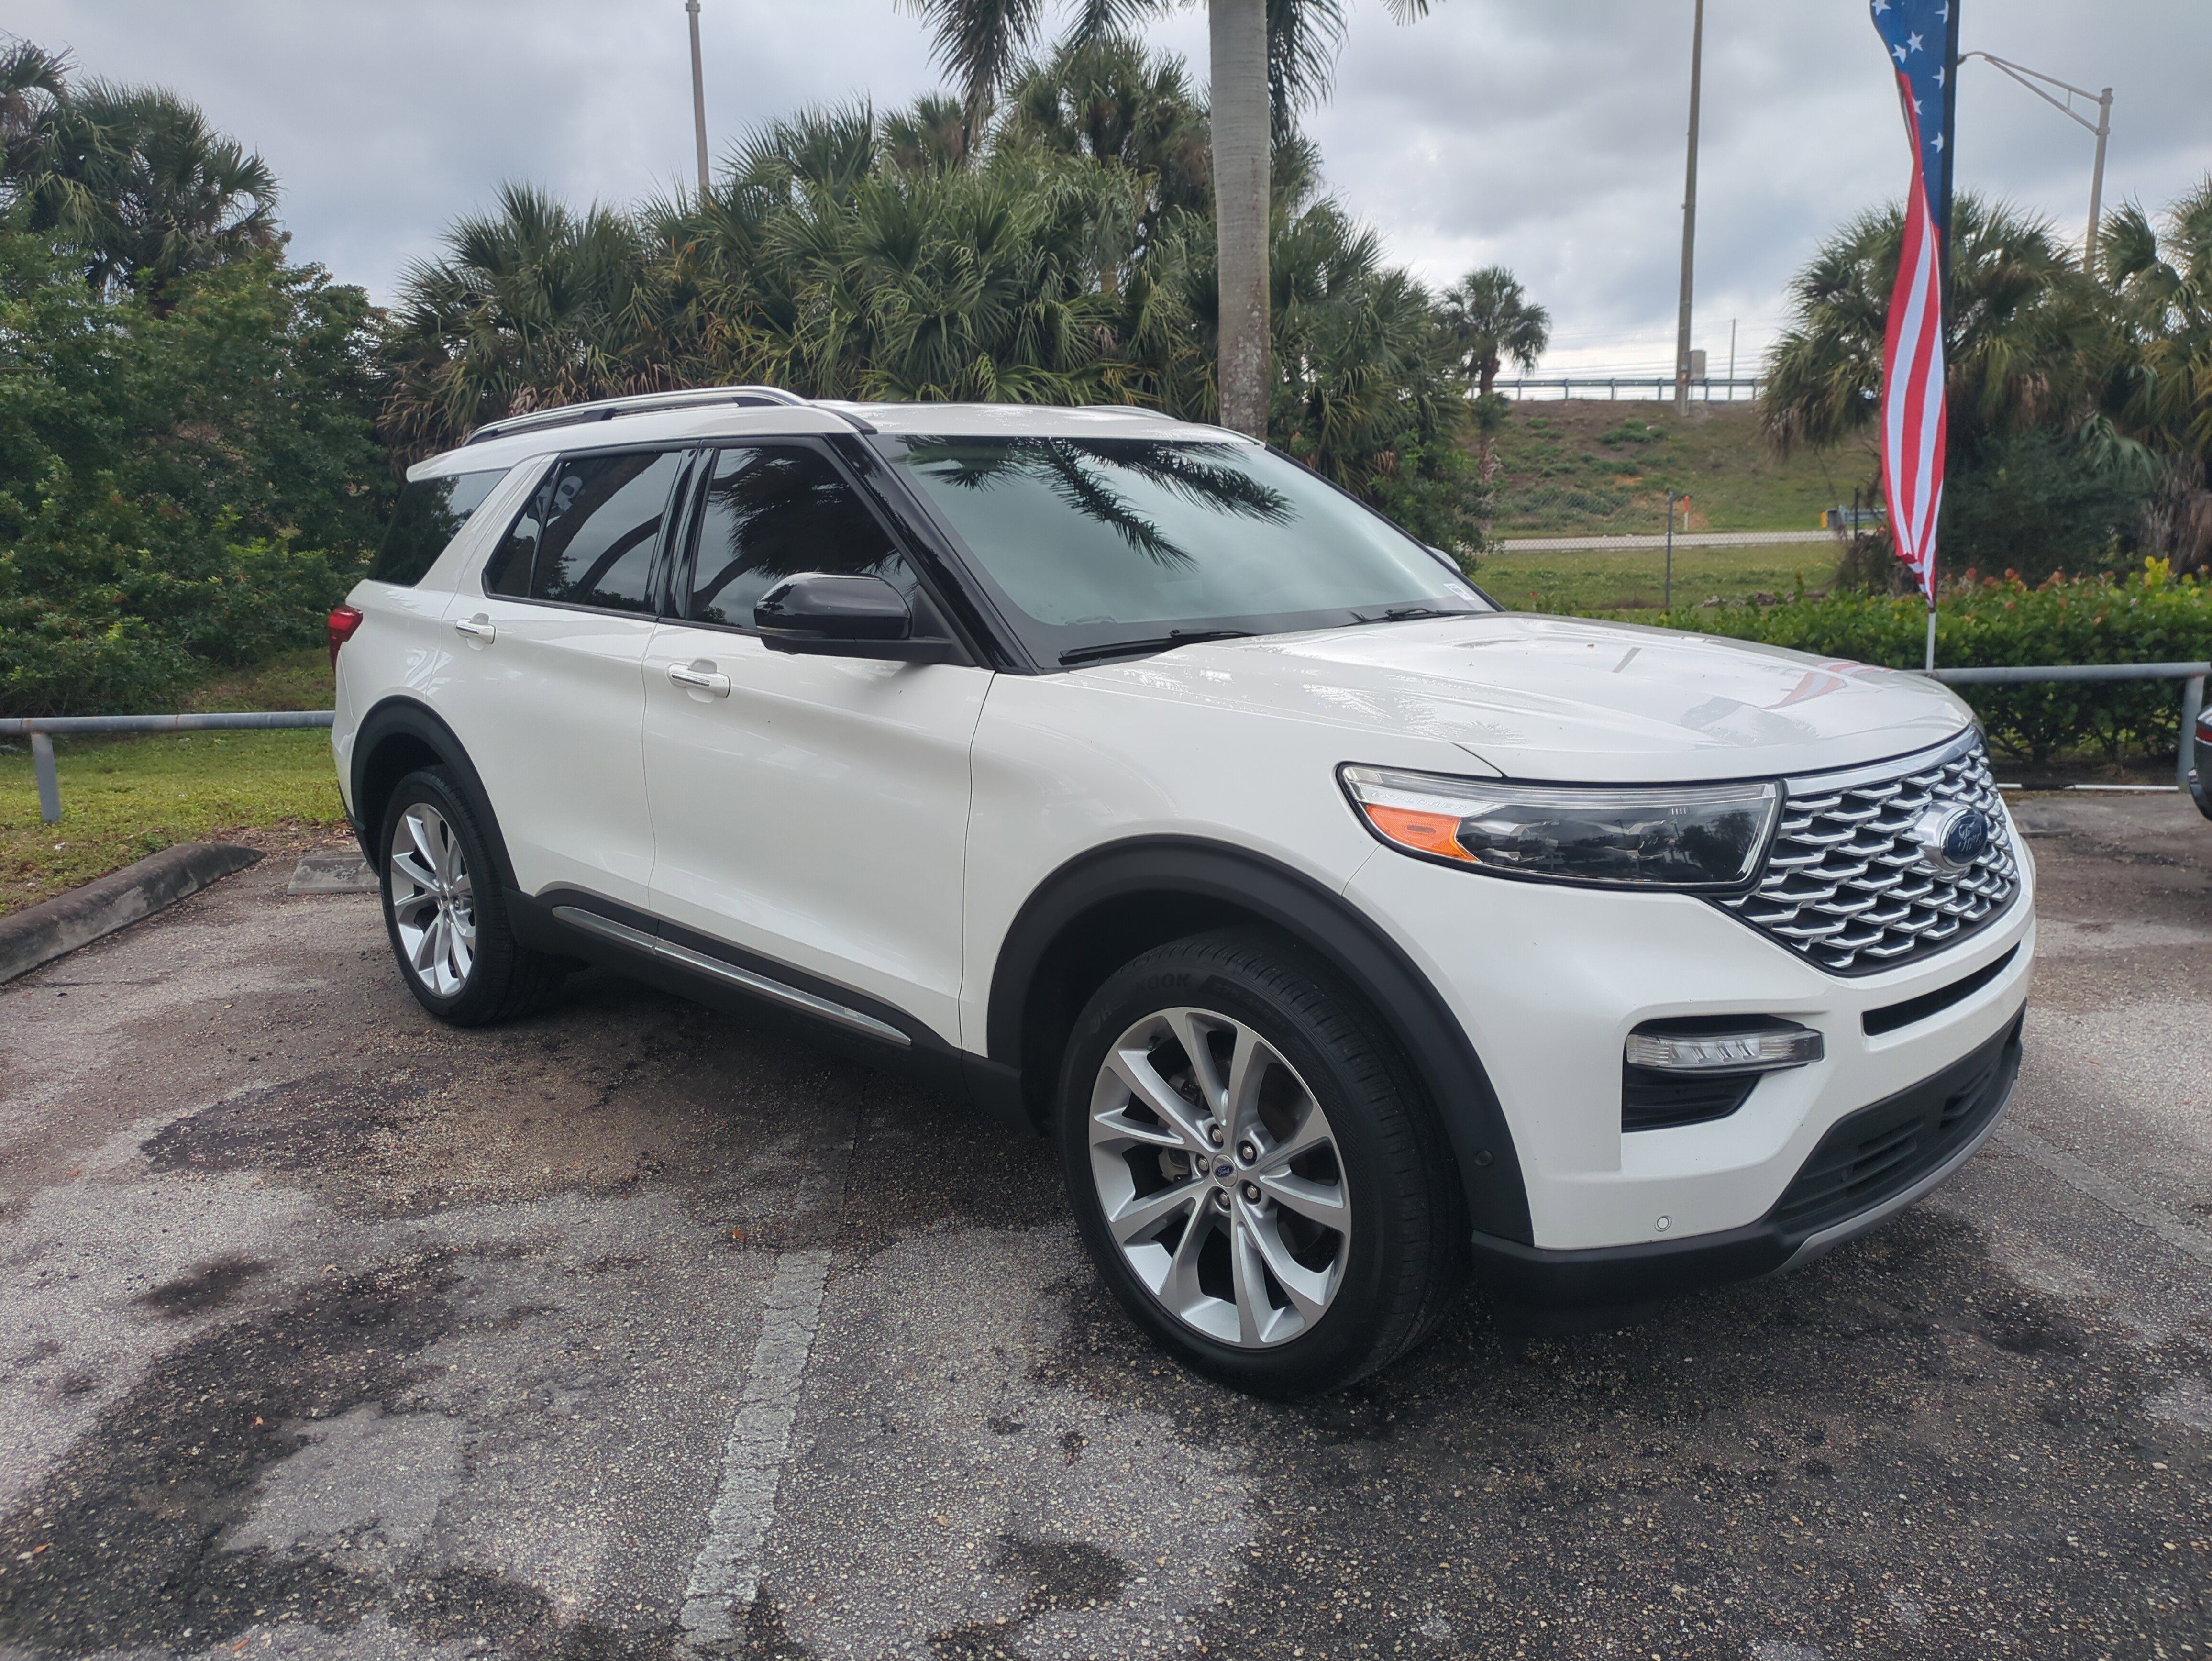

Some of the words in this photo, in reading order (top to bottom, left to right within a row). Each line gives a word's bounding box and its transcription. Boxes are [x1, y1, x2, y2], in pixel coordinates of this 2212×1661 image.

[1372, 791, 1467, 810] EXPLORER
[1958, 814, 1982, 852] Ford
[1217, 1167, 1230, 1176] Ford
